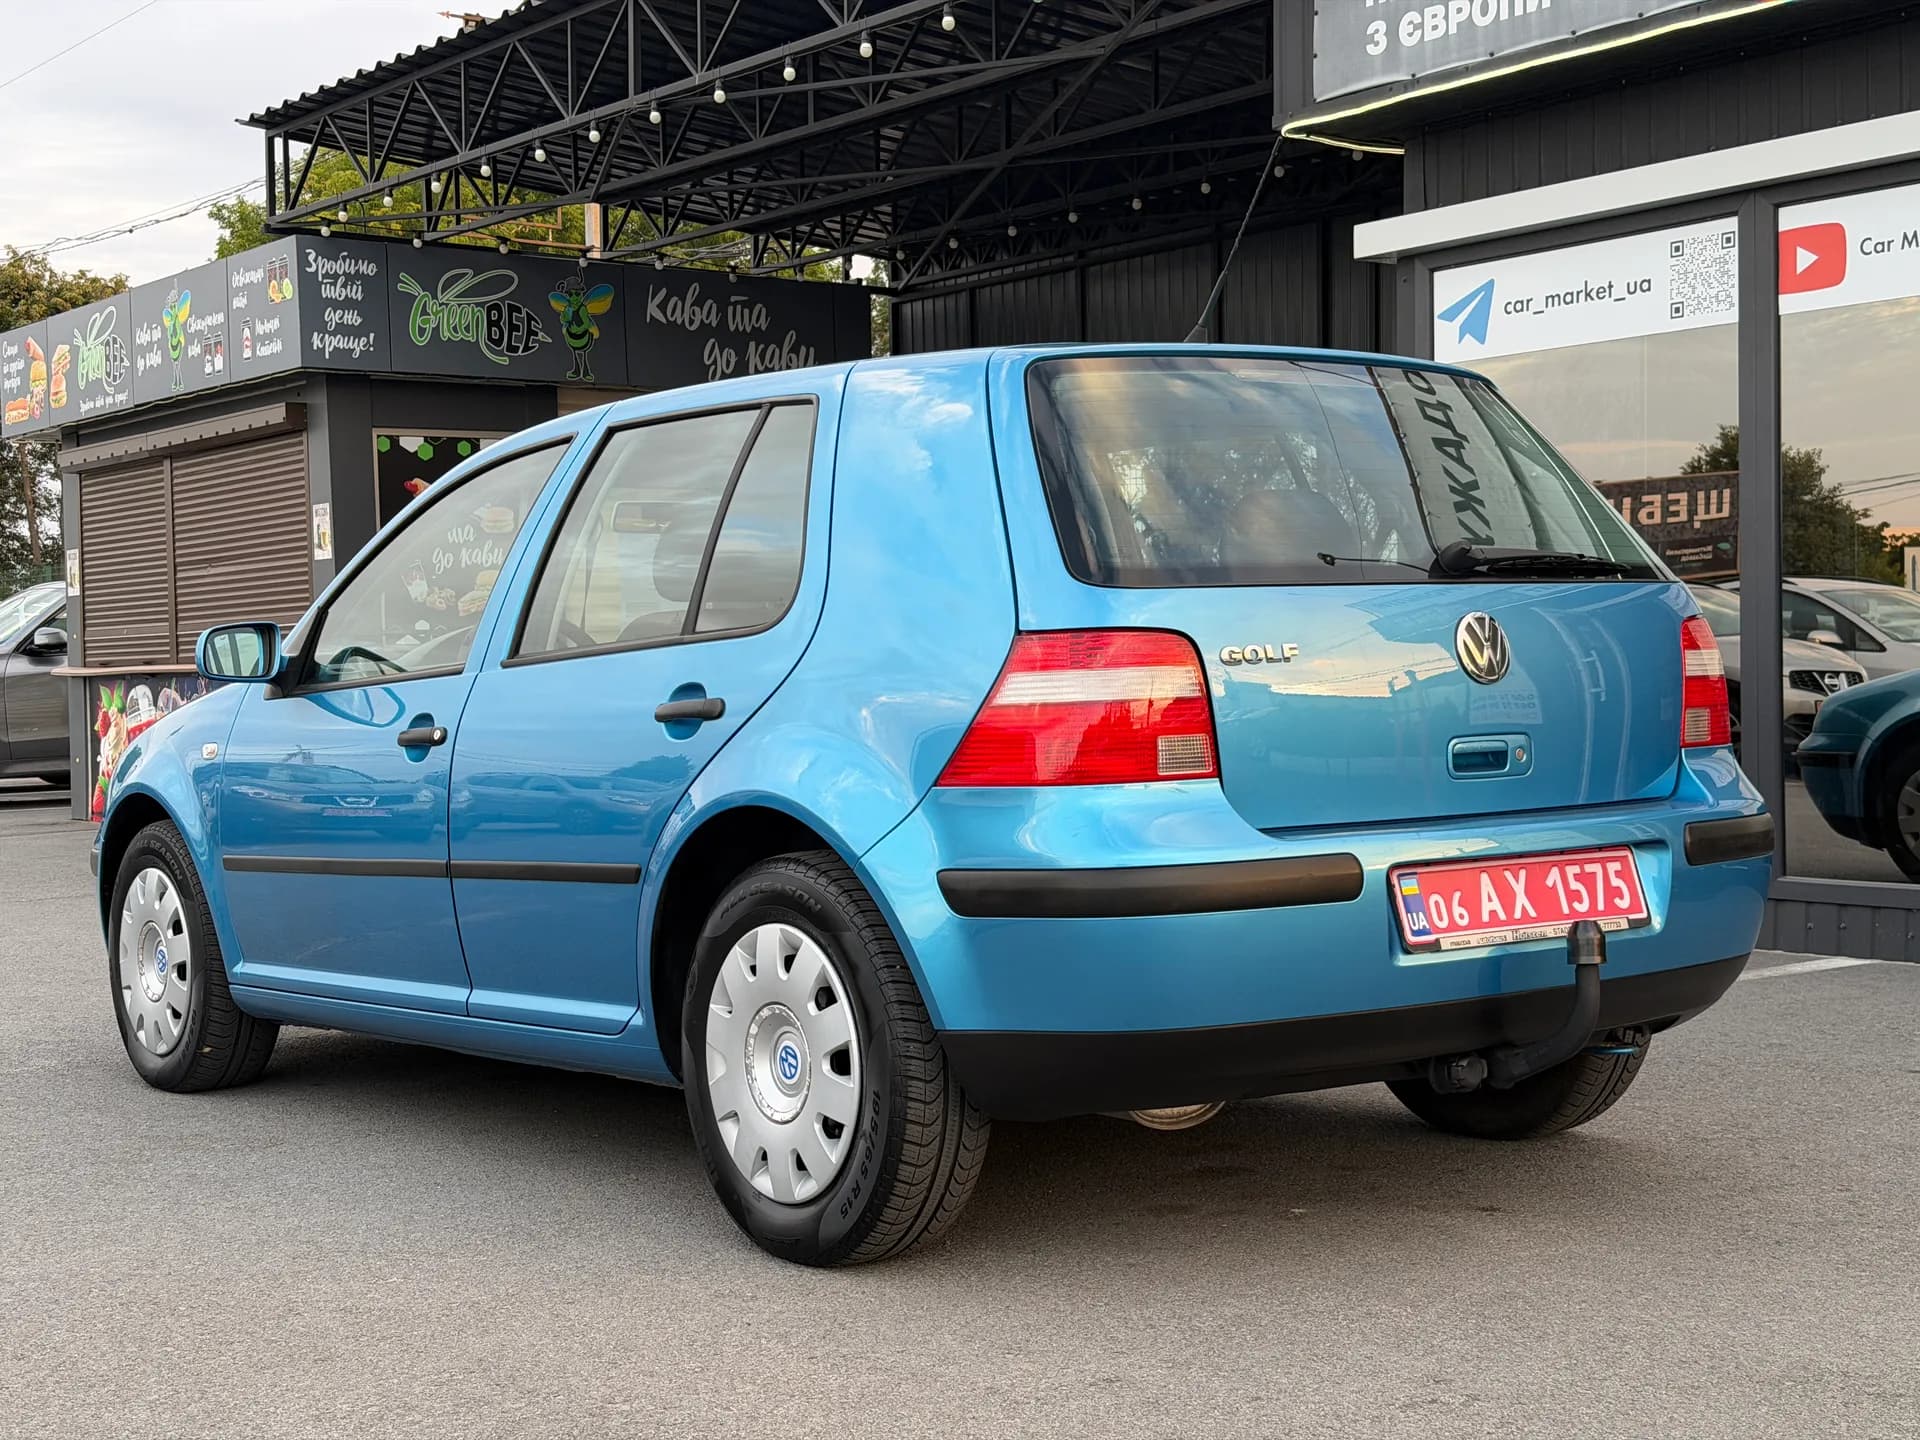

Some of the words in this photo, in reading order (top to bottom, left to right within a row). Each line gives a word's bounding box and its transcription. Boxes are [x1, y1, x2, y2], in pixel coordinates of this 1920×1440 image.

[1860, 237, 1894, 256] Car
[1900, 230, 1920, 250] M
[305, 249, 378, 281] Зробимо
[321, 276, 364, 301] твій
[1503, 278, 1652, 315] car_market_ua
[325, 307, 363, 331] день
[646, 282, 721, 331] Кава
[727, 295, 771, 333] та
[311, 331, 375, 359] краще!
[704, 338, 738, 381] до
[746, 330, 818, 374] кави
[432, 547, 453, 575] до
[1219, 643, 1299, 666] GOLF
[1428, 890, 1470, 929] 06
[1545, 861, 1631, 915] 1575
[1408, 912, 1429, 931] UA
